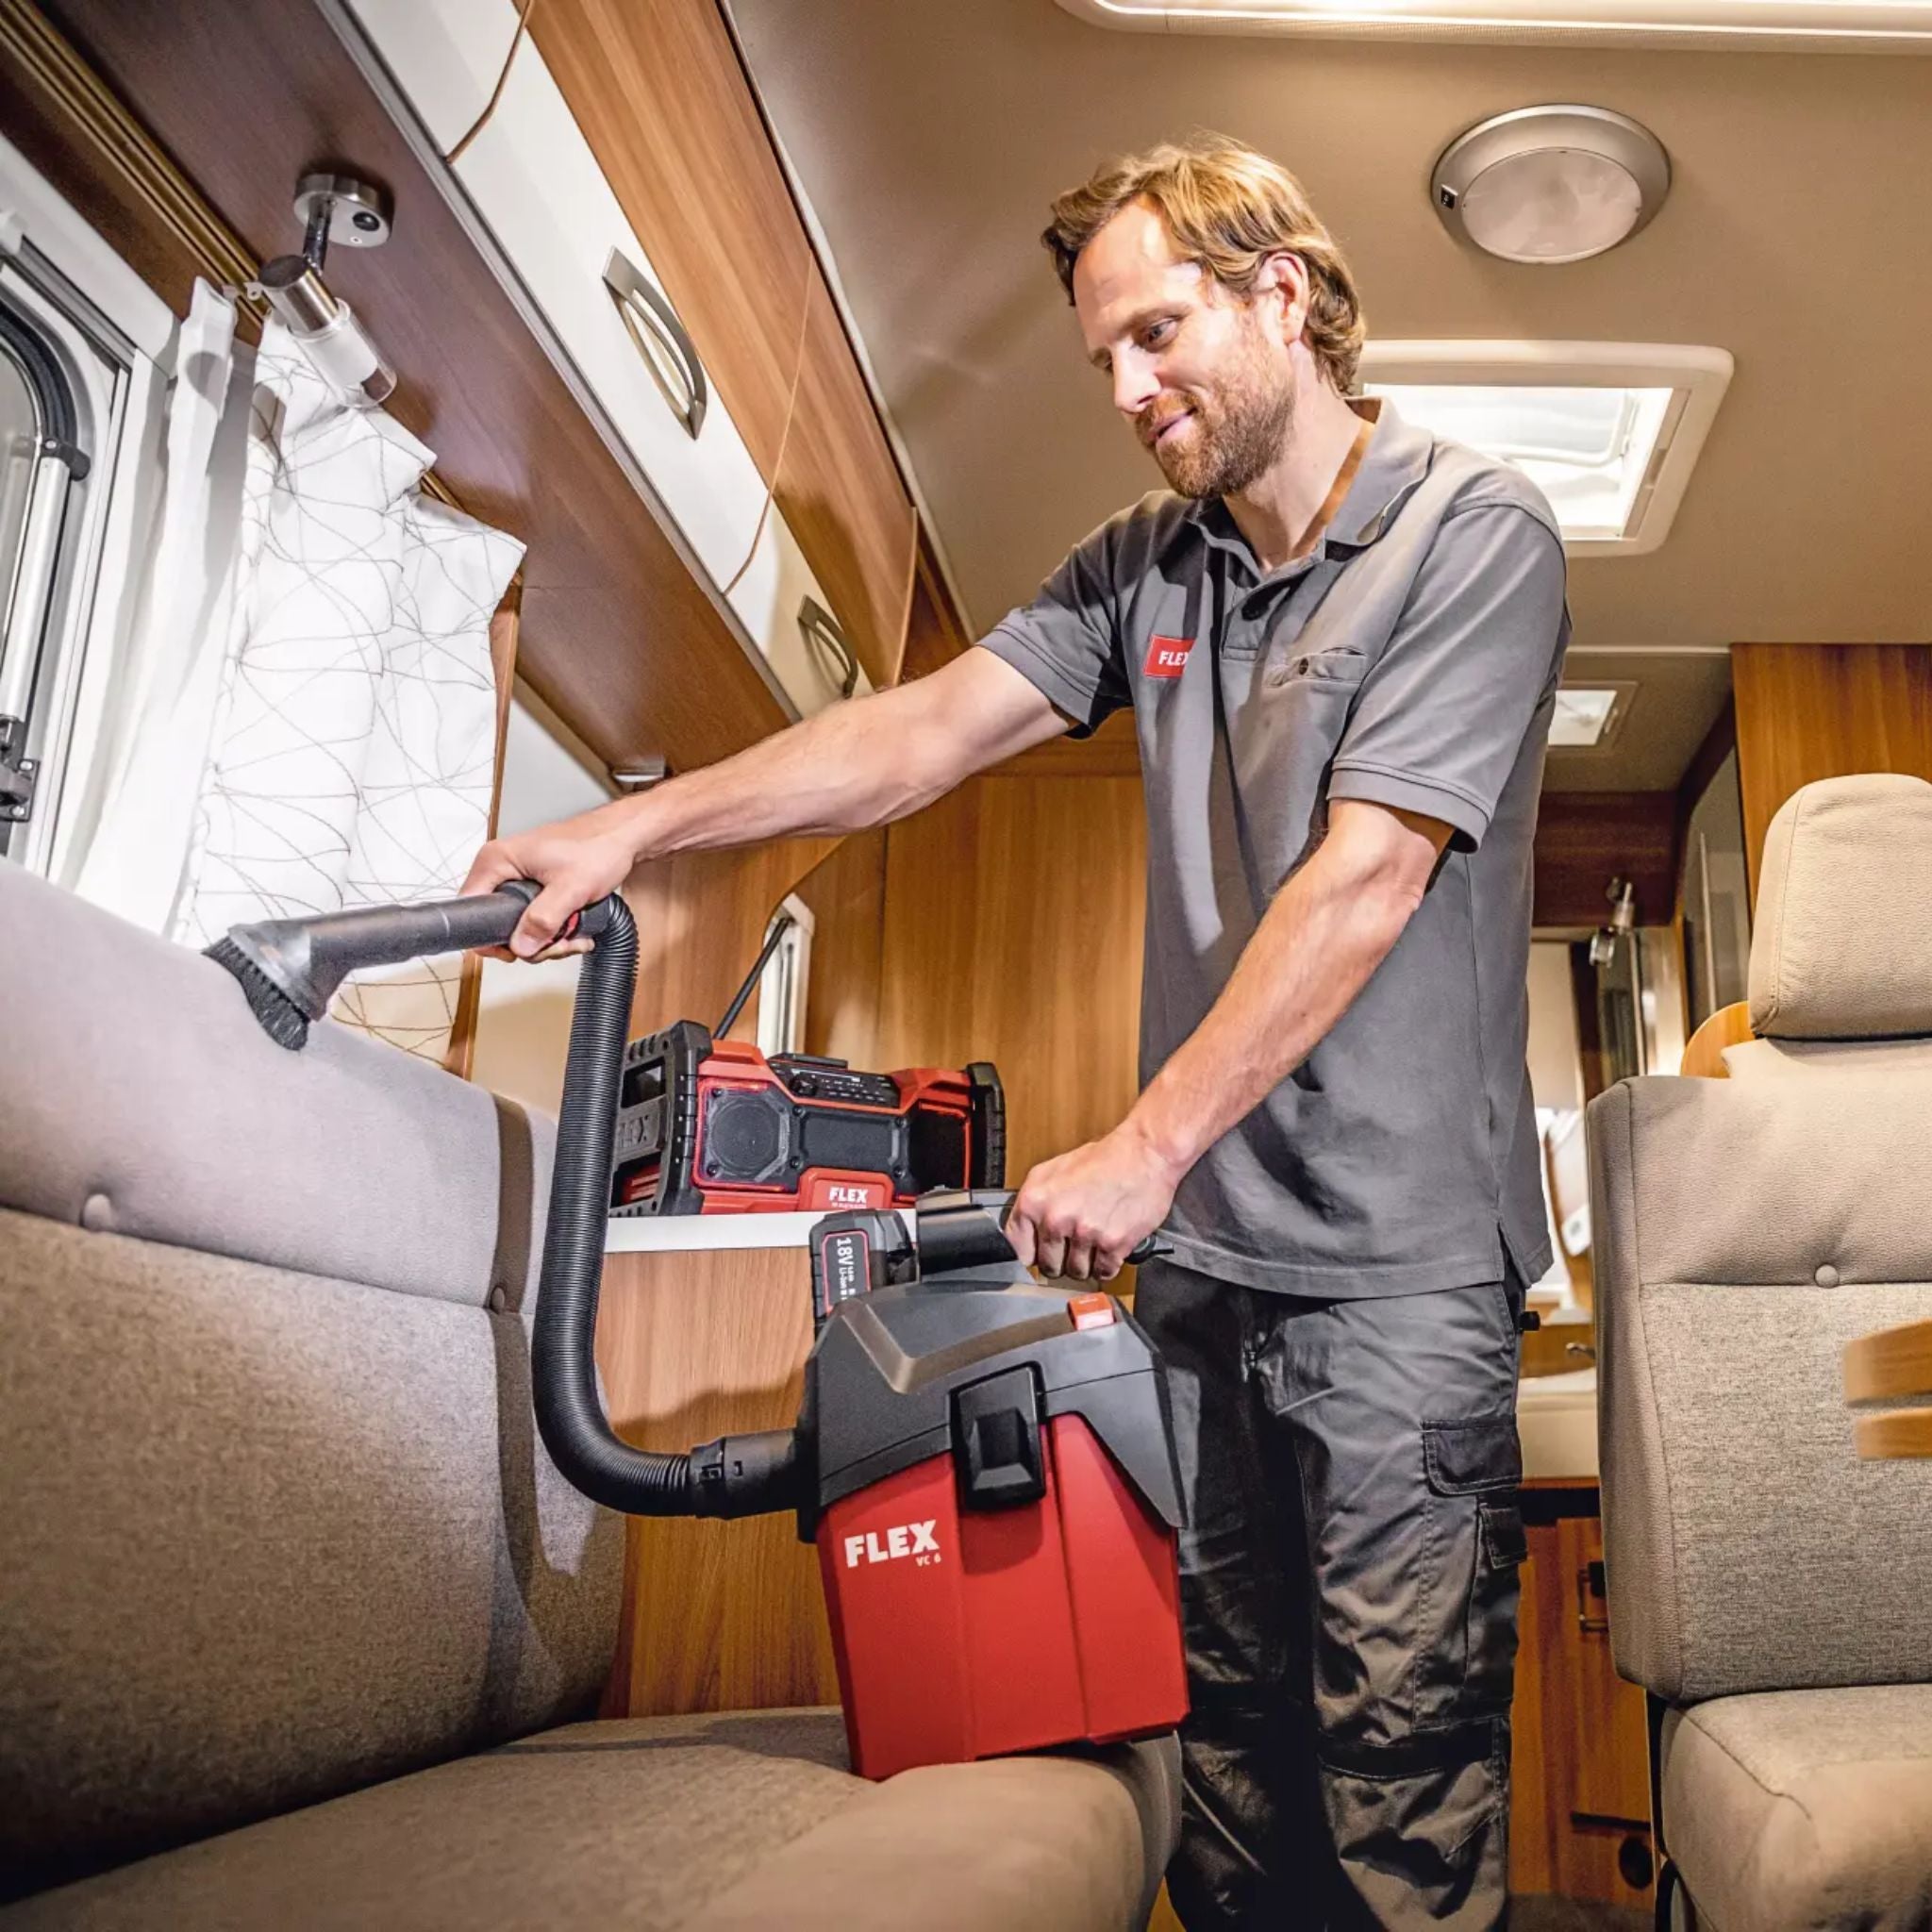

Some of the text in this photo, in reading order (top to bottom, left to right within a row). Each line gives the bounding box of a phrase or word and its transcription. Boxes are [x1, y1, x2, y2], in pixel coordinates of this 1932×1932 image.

[829, 1186, 869, 1204] FLEX
[837, 1237, 855, 1266] 18V
[844, 1519, 941, 1569] FLEX
[916, 1553, 941, 1567] VC 6
